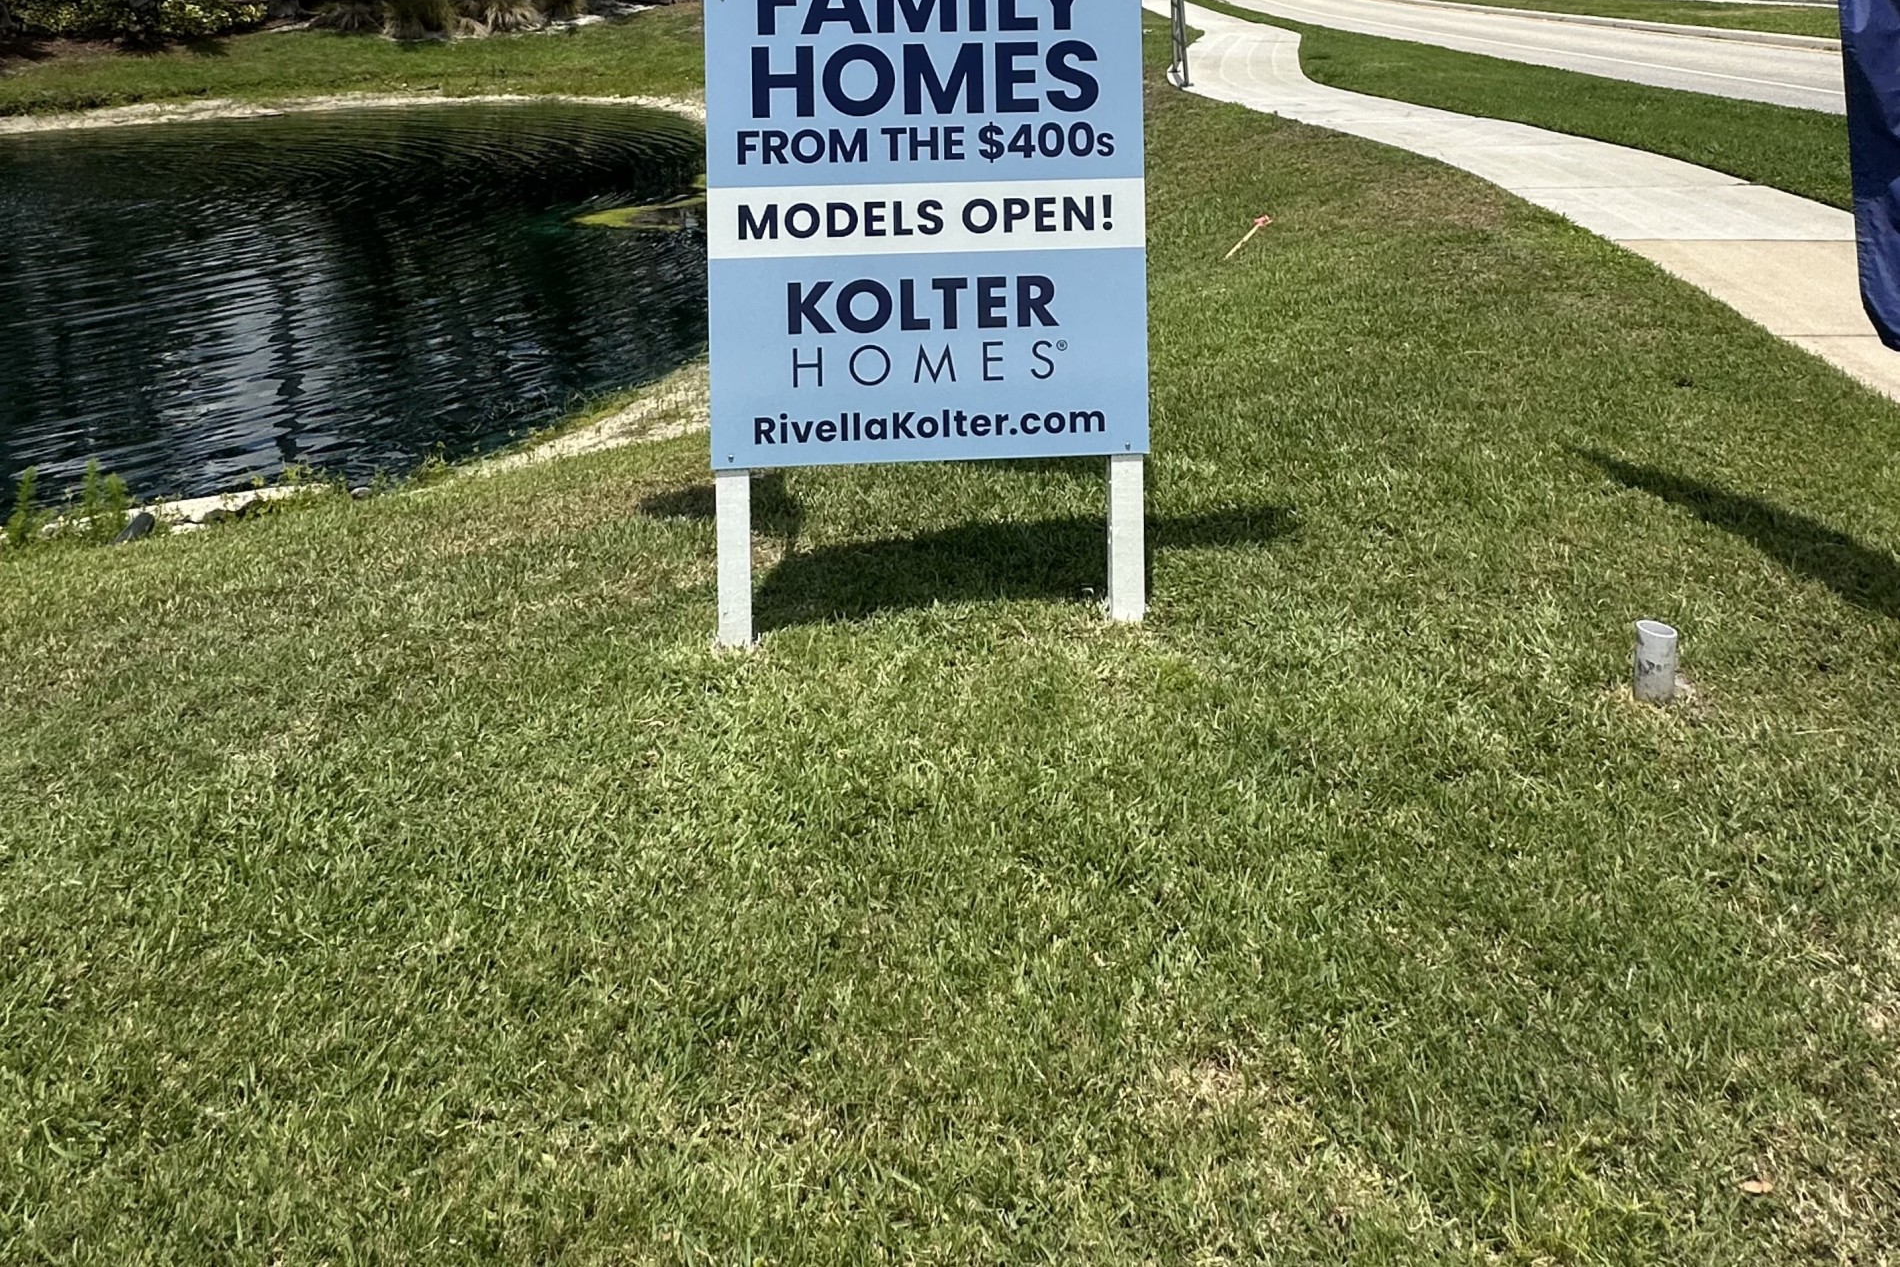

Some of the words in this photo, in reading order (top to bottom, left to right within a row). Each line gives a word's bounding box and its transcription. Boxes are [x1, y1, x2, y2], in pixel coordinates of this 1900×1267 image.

[751, 39, 1100, 120] HOMES
[736, 127, 868, 166] FROM
[880, 125, 966, 162] THE
[977, 120, 1116, 164] $400s
[737, 198, 945, 241] MODELS
[961, 194, 1114, 235] OPEN!
[786, 274, 1061, 336] KOLTER
[753, 409, 1107, 446] RivellaKolter.com
